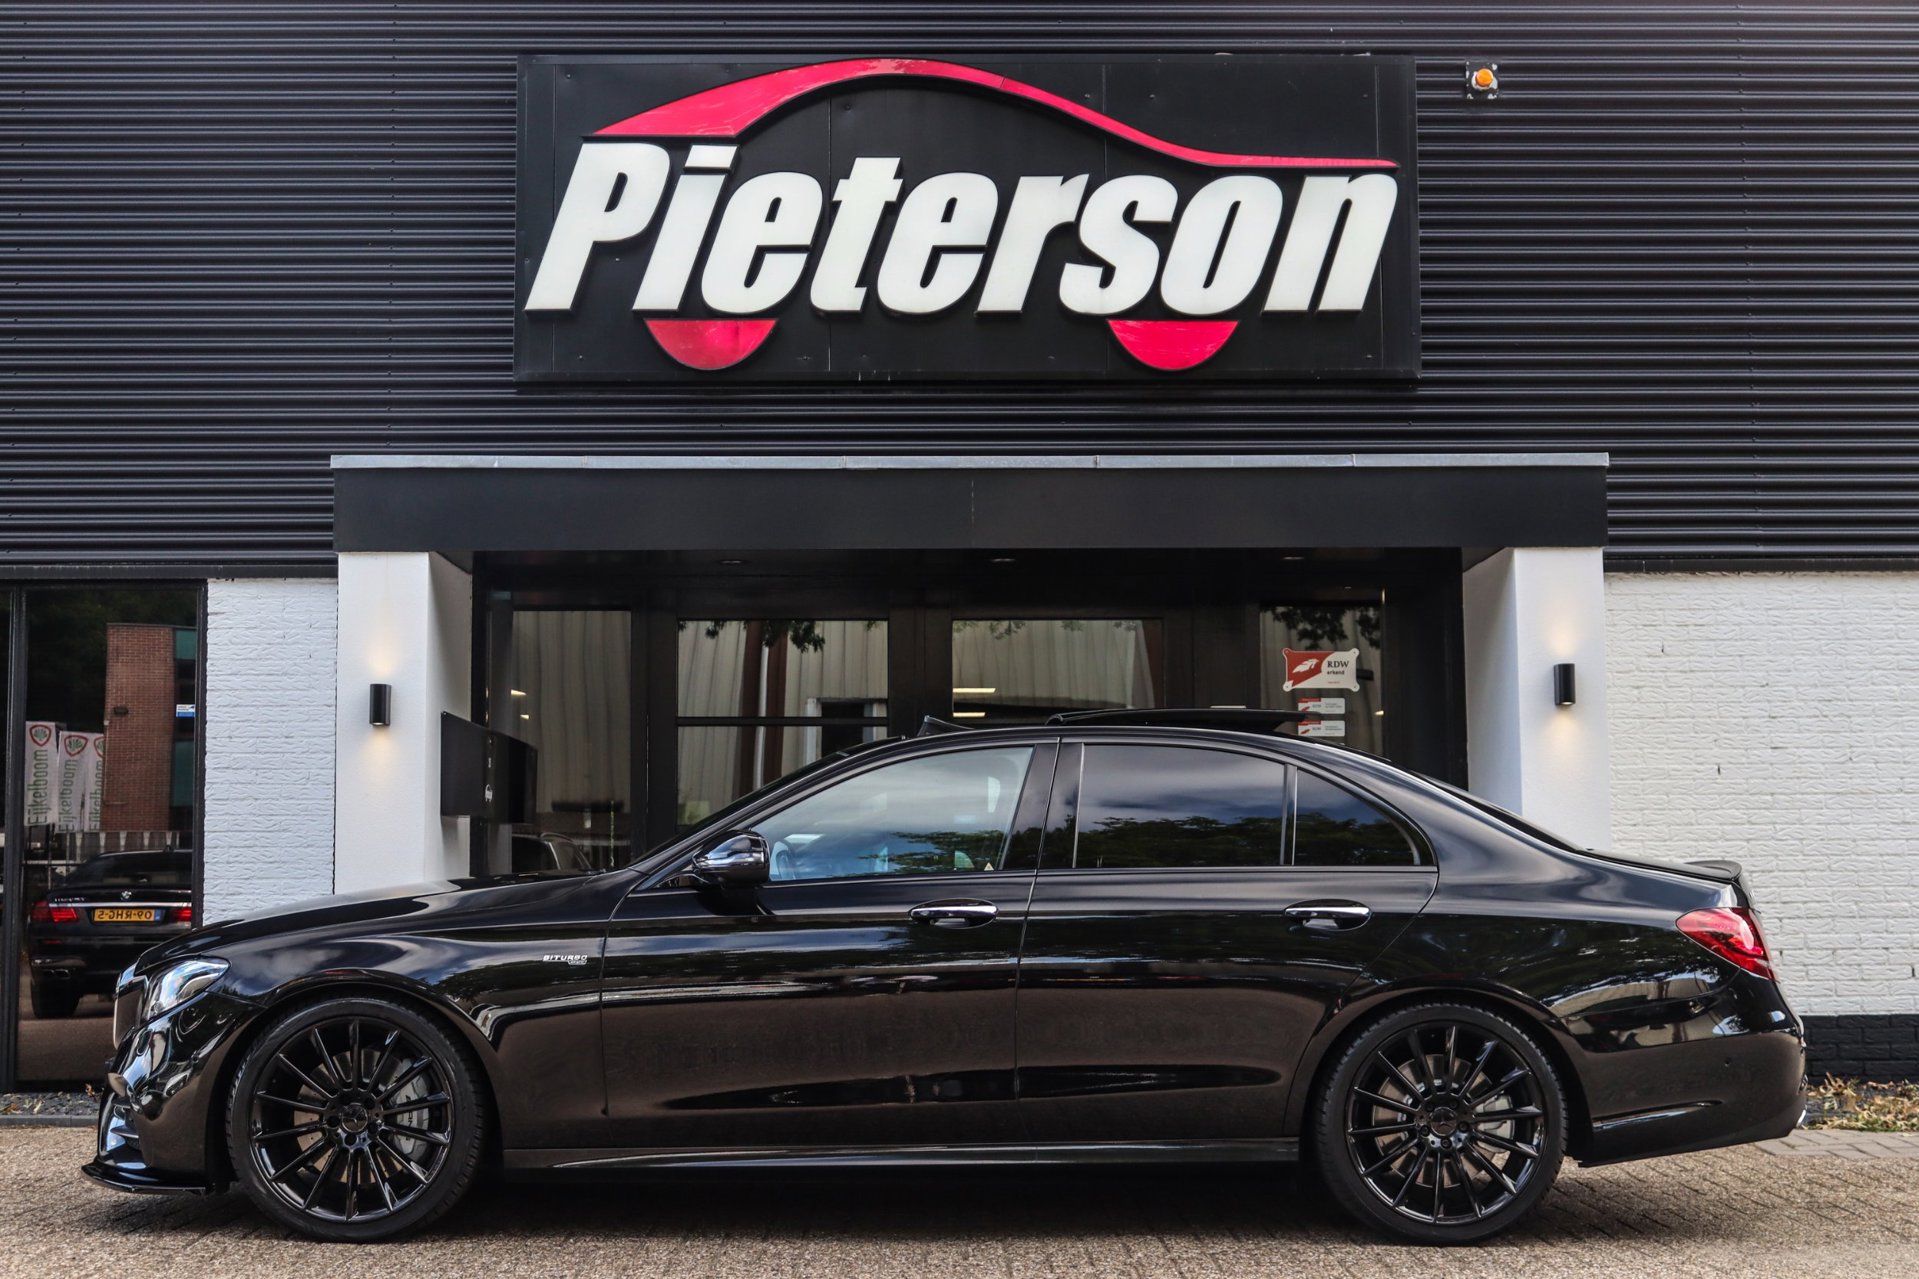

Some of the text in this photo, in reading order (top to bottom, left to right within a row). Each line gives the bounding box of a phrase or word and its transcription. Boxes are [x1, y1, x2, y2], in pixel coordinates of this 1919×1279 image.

[524, 141, 1400, 316] Pieterson
[1327, 660, 1350, 668] RDW
[27, 749, 51, 825] Eijkelboom
[543, 954, 588, 962] BITURBO
